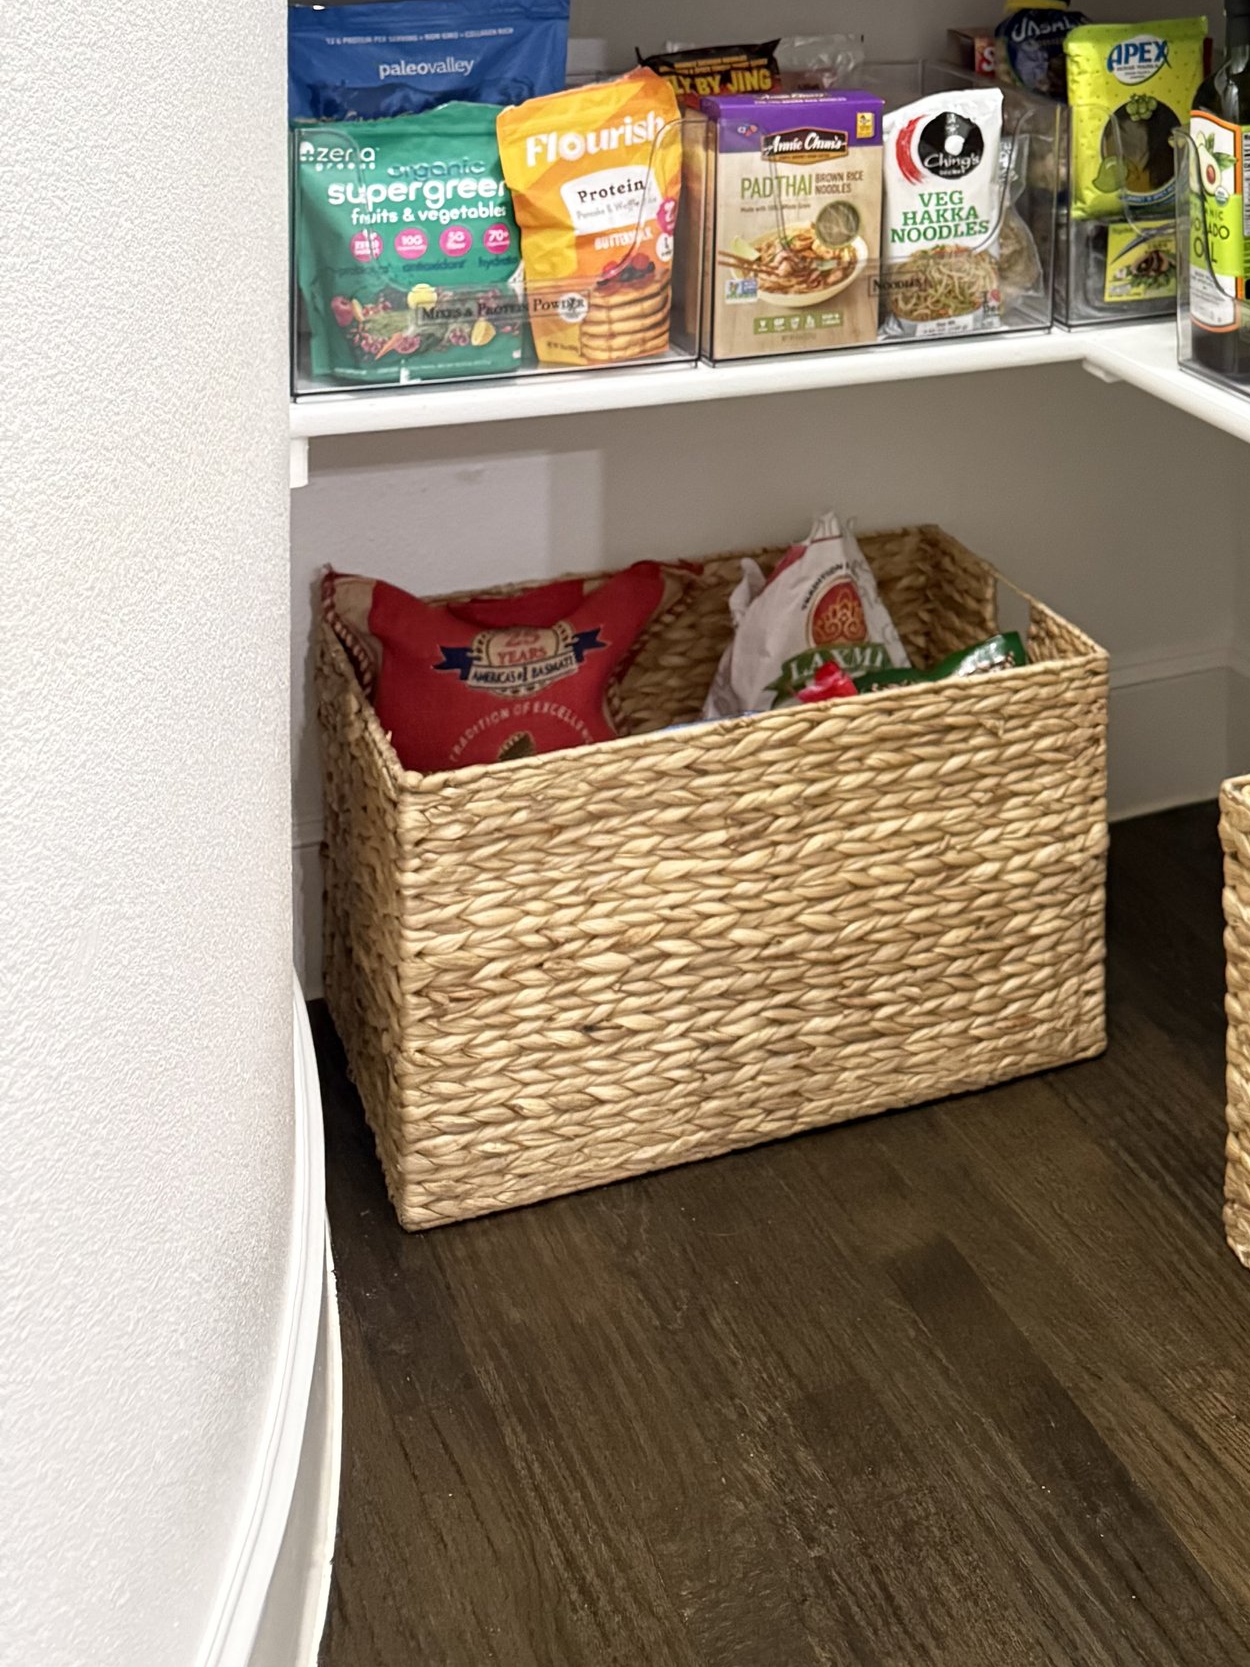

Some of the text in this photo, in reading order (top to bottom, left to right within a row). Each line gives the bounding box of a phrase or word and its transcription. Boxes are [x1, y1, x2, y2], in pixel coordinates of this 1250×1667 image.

[379, 56, 475, 80] paleovalley
[1106, 39, 1172, 74] APEX
[672, 67, 773, 96] LY BY JING
[525, 110, 665, 168] Flourish
[764, 132, 846, 153] Annie Chun's
[386, 157, 487, 182] organic
[923, 152, 980, 170] Ching's
[577, 178, 646, 204] Protein
[740, 170, 864, 200] PAD THAI BROWN RICE
[815, 182, 852, 196] NOODLES
[918, 189, 964, 207] VEG
[351, 207, 415, 225] fruits &
[902, 205, 980, 227] HAKKA
[890, 219, 990, 244] NOODLES
[422, 306, 462, 321] MIXES
[505, 632, 541, 648] 25
[497, 645, 548, 666] YEARS
[788, 648, 885, 683] LAXMI
[472, 669, 516, 684] AMERICA'S
[531, 655, 575, 679] BASMATI
[532, 700, 595, 745] EXCELLEN
